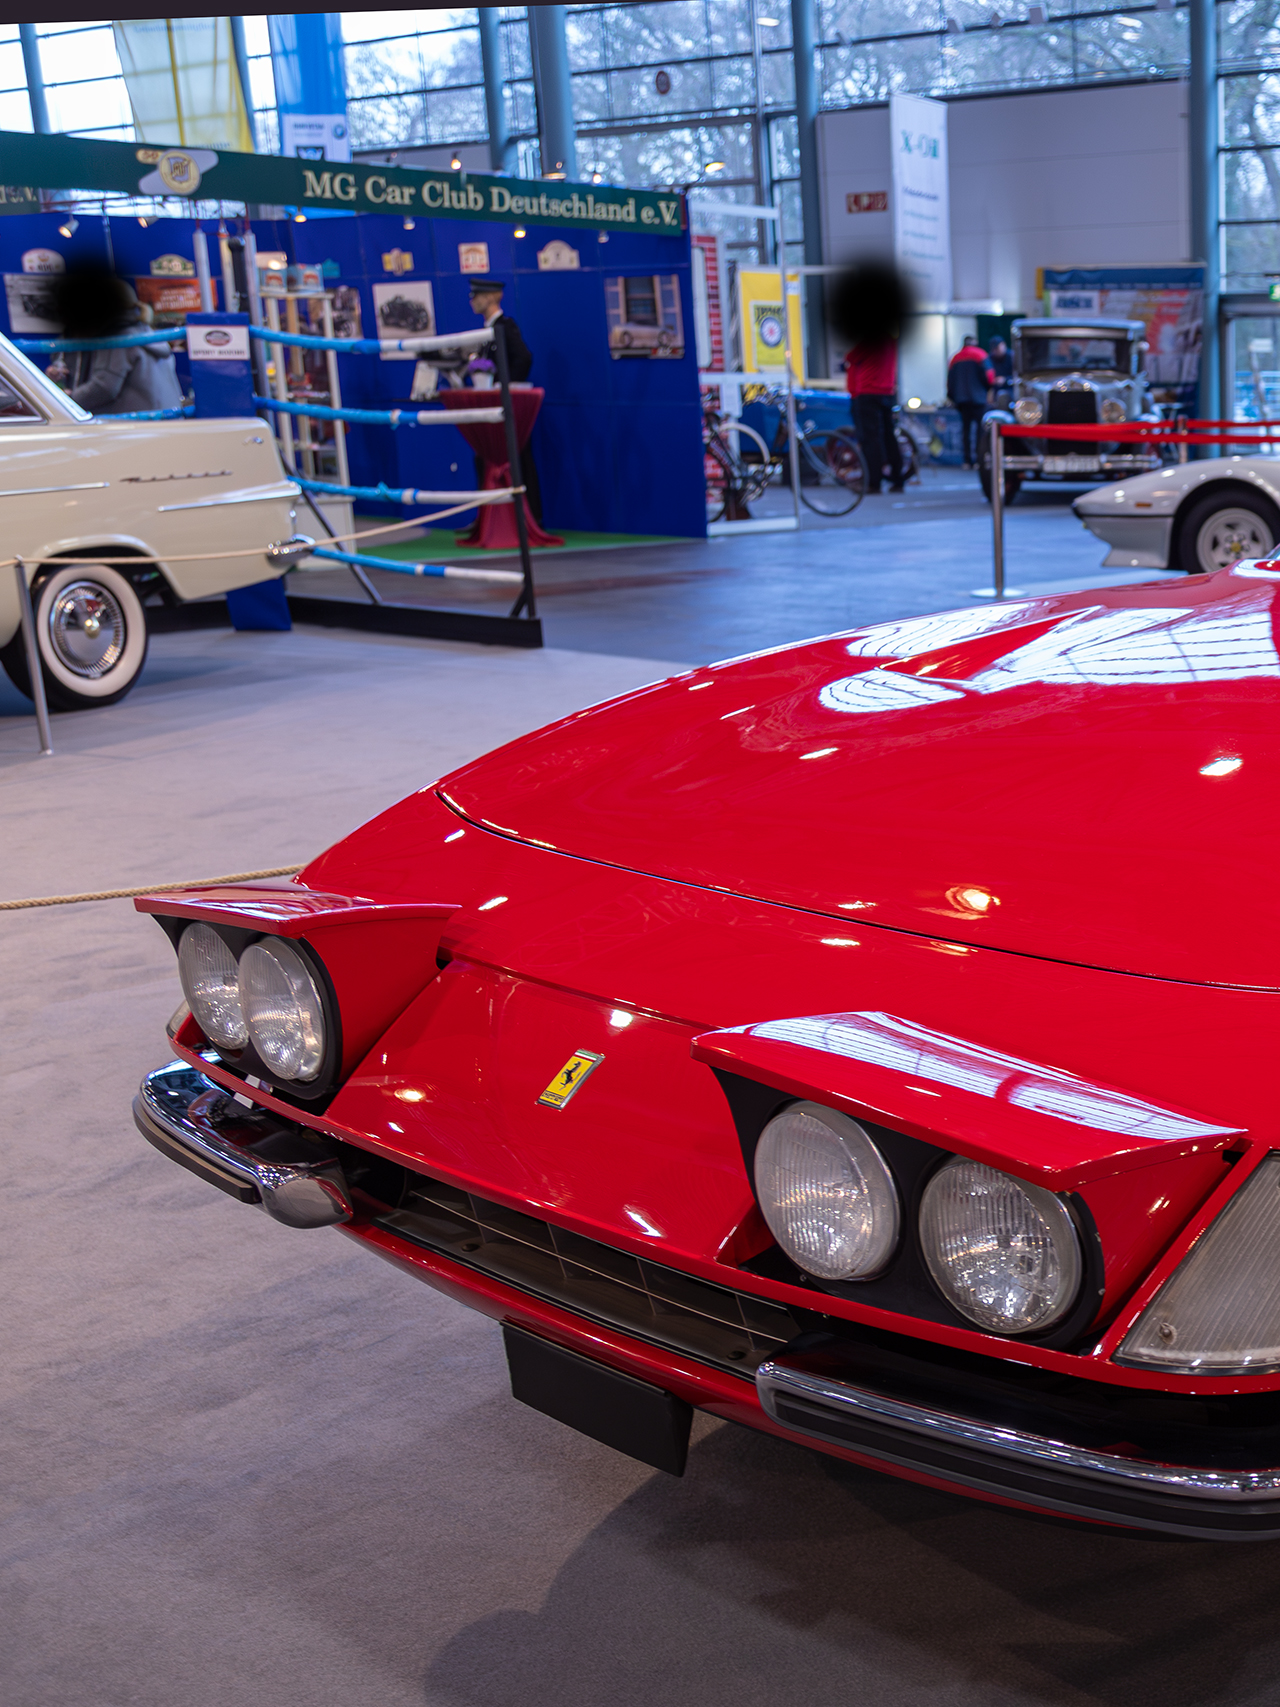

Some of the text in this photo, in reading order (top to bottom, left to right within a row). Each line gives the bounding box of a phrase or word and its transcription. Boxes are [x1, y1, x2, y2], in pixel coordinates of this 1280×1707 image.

[302, 169, 679, 227] MG Car Club Deutschland e.V.
